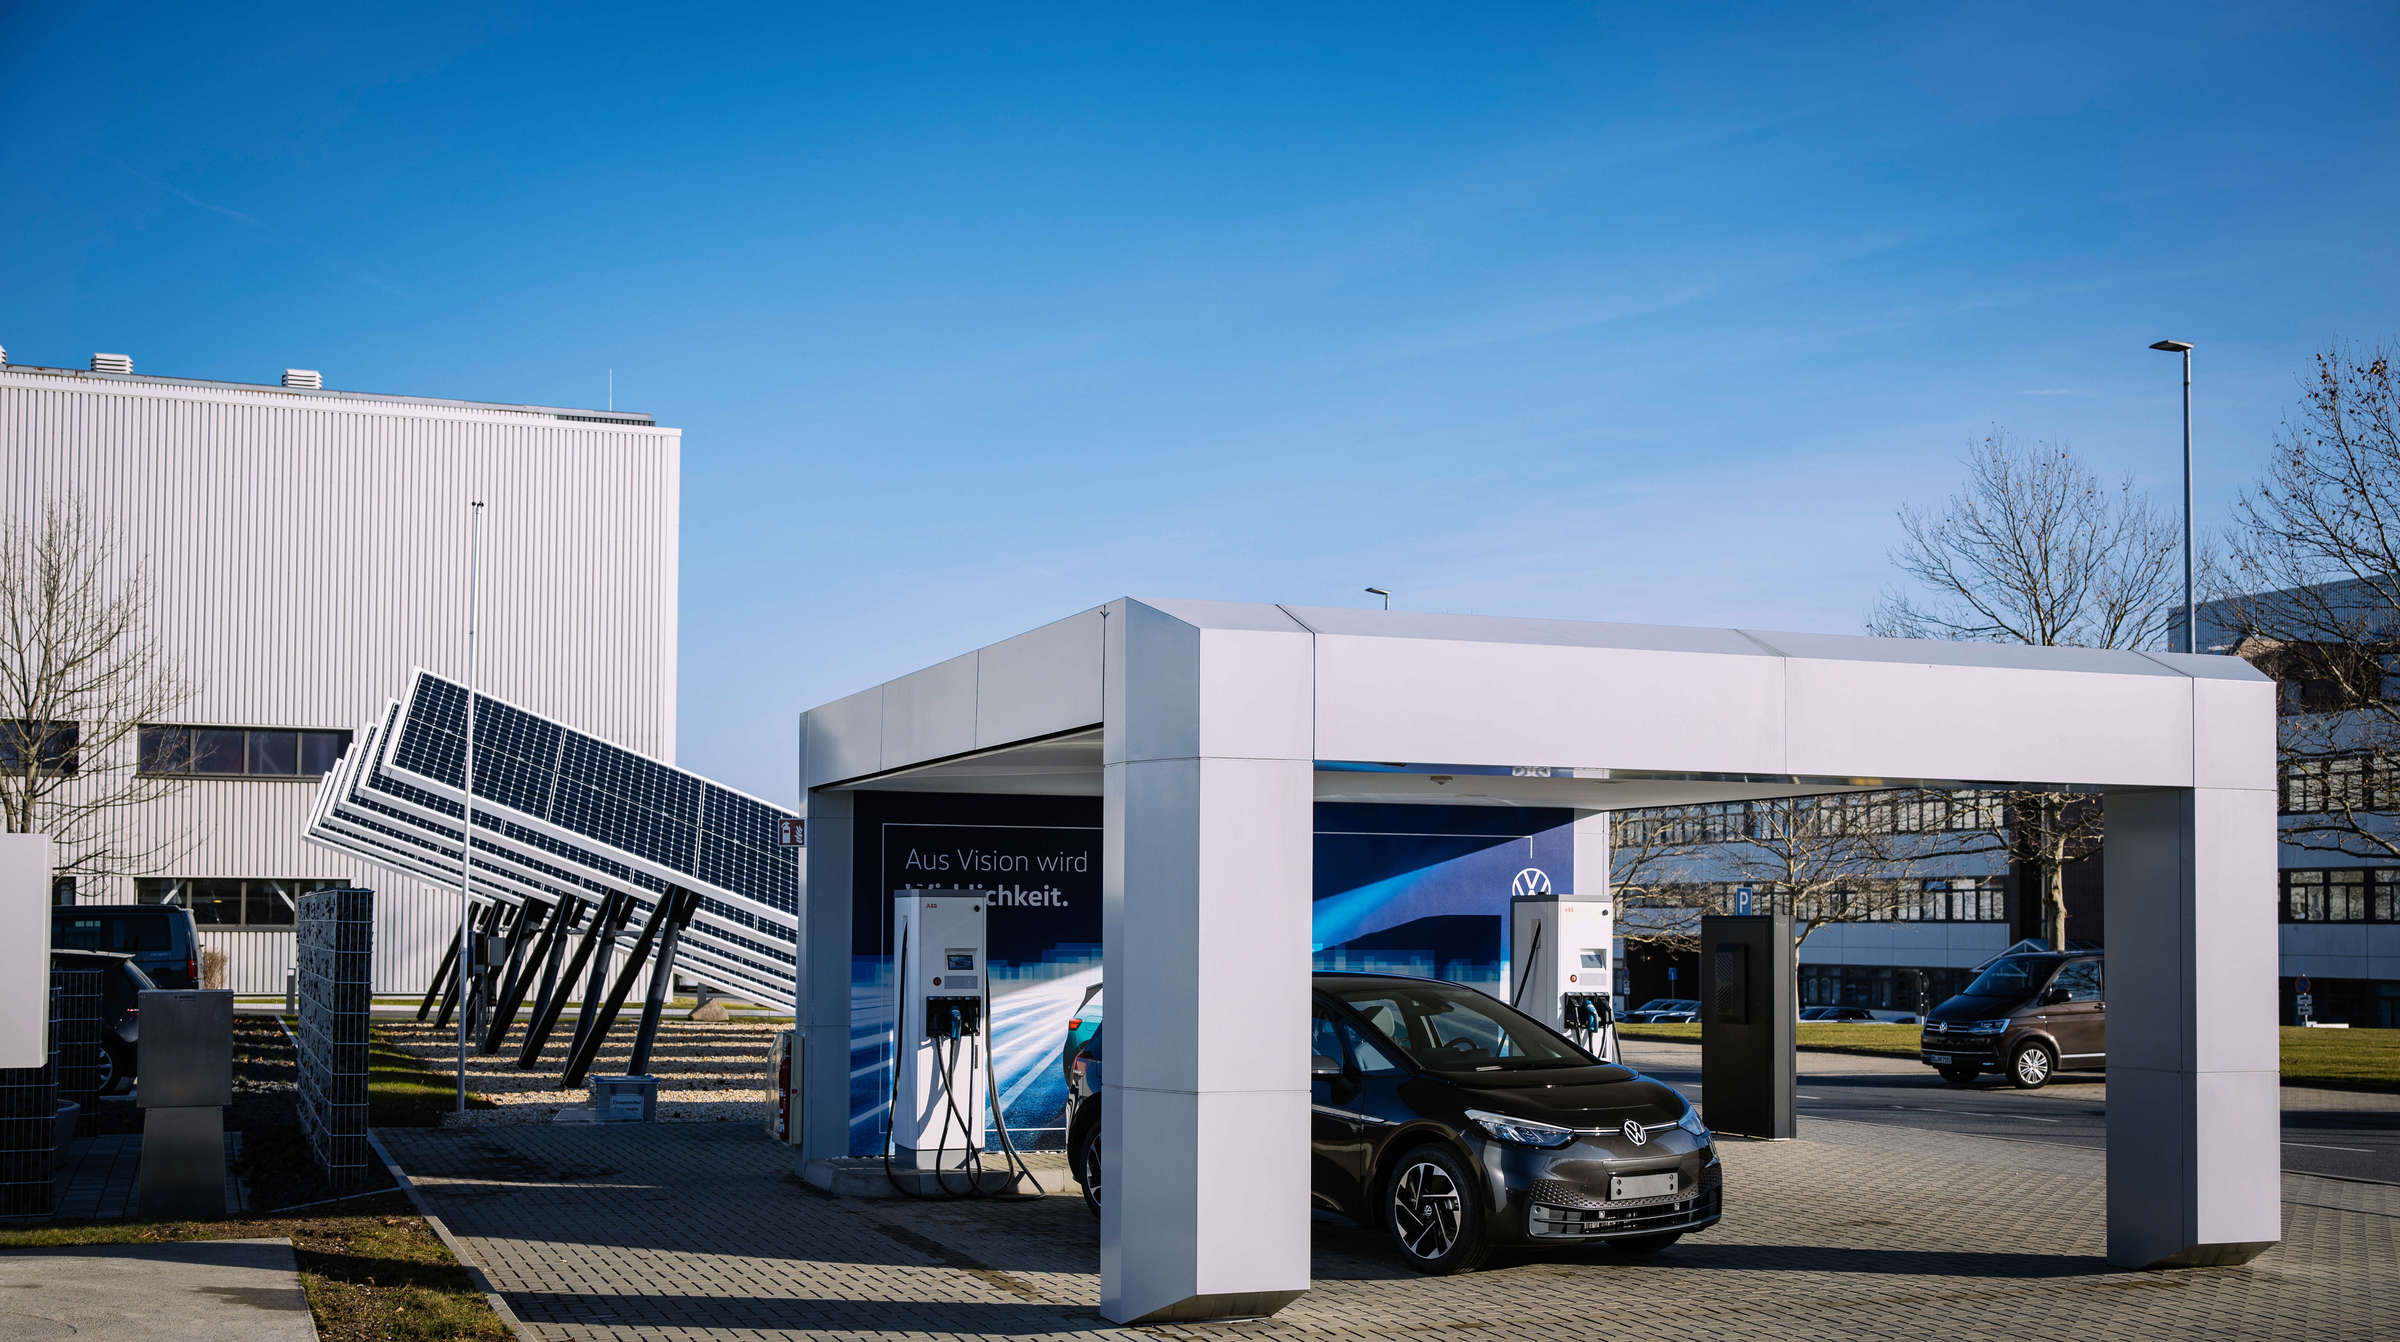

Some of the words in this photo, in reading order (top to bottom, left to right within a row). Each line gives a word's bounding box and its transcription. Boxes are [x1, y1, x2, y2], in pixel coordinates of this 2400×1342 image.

[905, 848, 950, 871] Aus
[957, 849, 1028, 872] Vision
[1037, 850, 1087, 873] wird
[905, 883, 1069, 907] chkeit.
[1739, 891, 1749, 914] P
